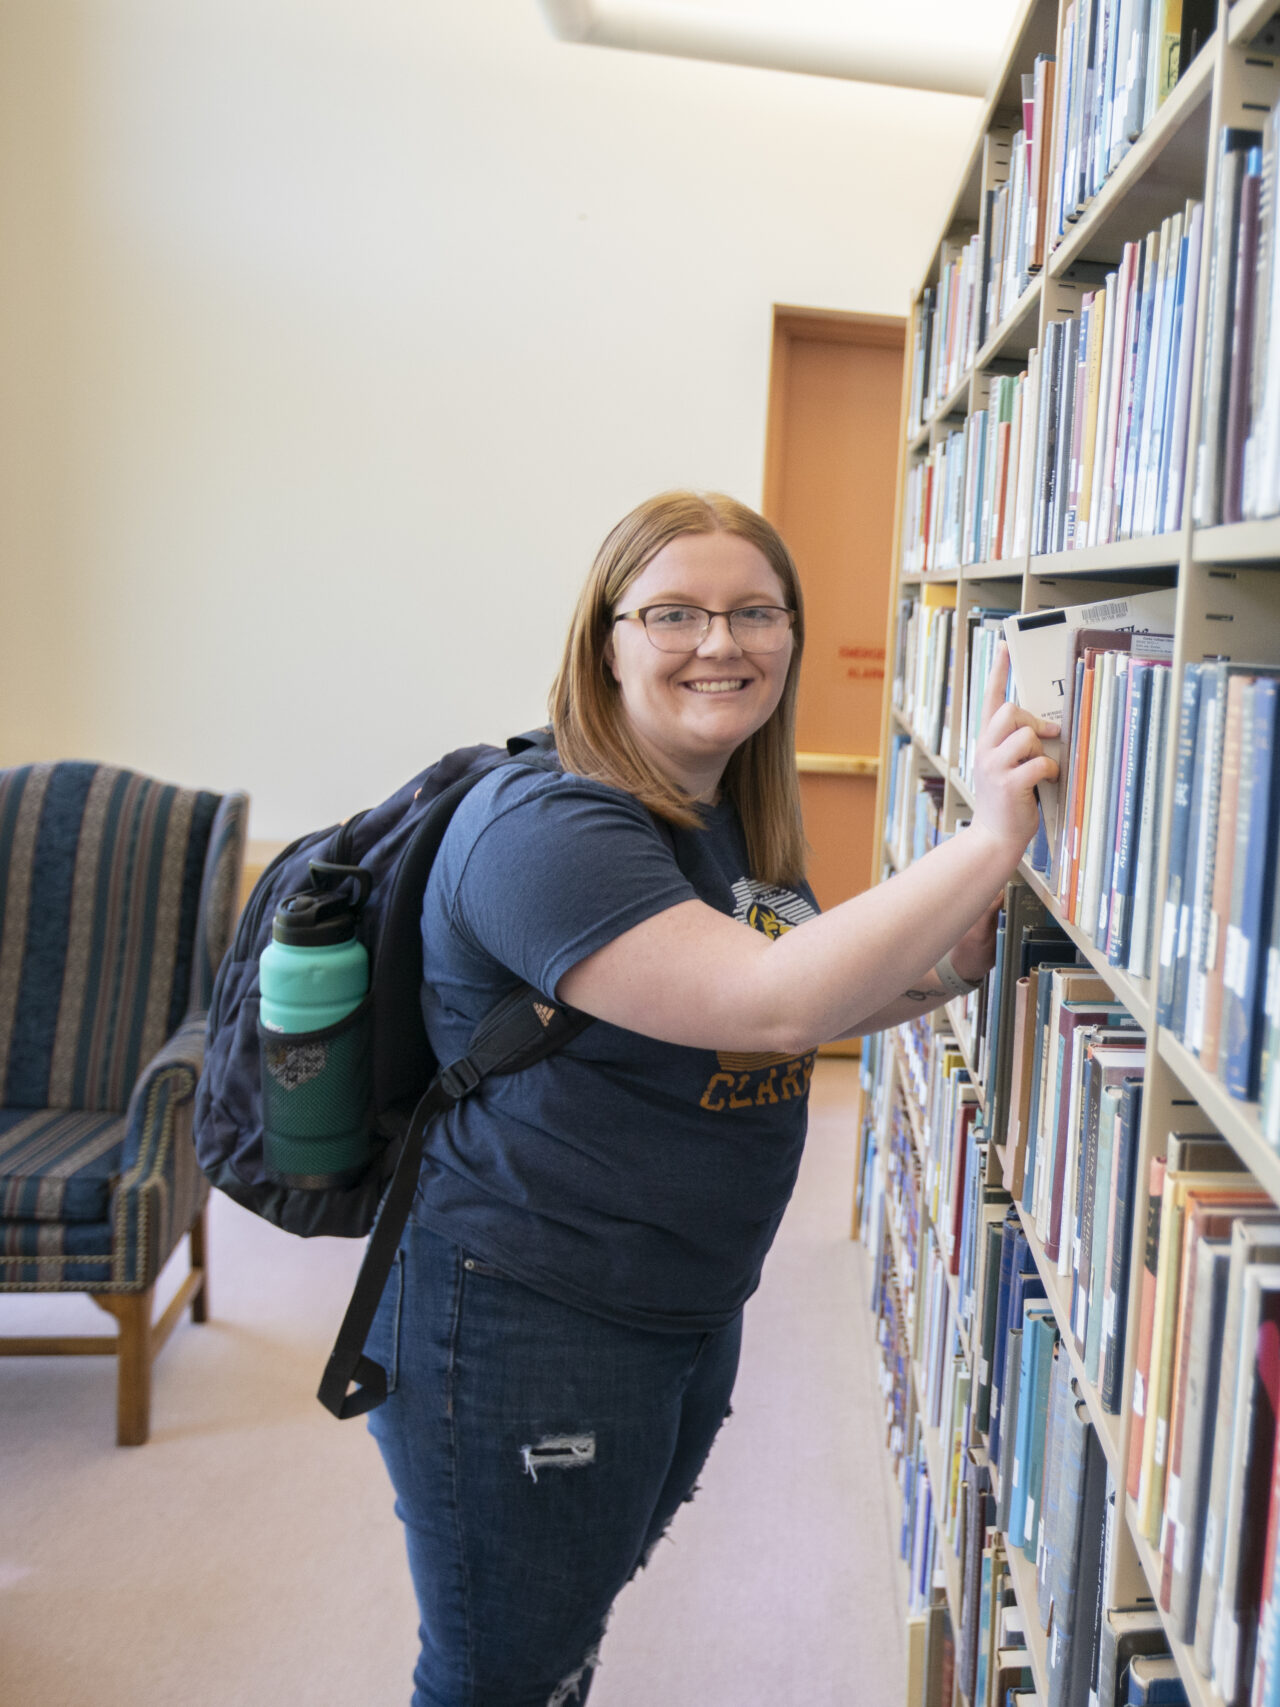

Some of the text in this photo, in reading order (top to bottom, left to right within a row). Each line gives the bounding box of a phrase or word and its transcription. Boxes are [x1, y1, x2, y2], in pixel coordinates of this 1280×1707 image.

[1126, 707, 1138, 786] Reformation
[1123, 791, 1132, 816] and
[1119, 820, 1130, 869] Society
[1089, 1102, 1099, 1176] MARTIN
